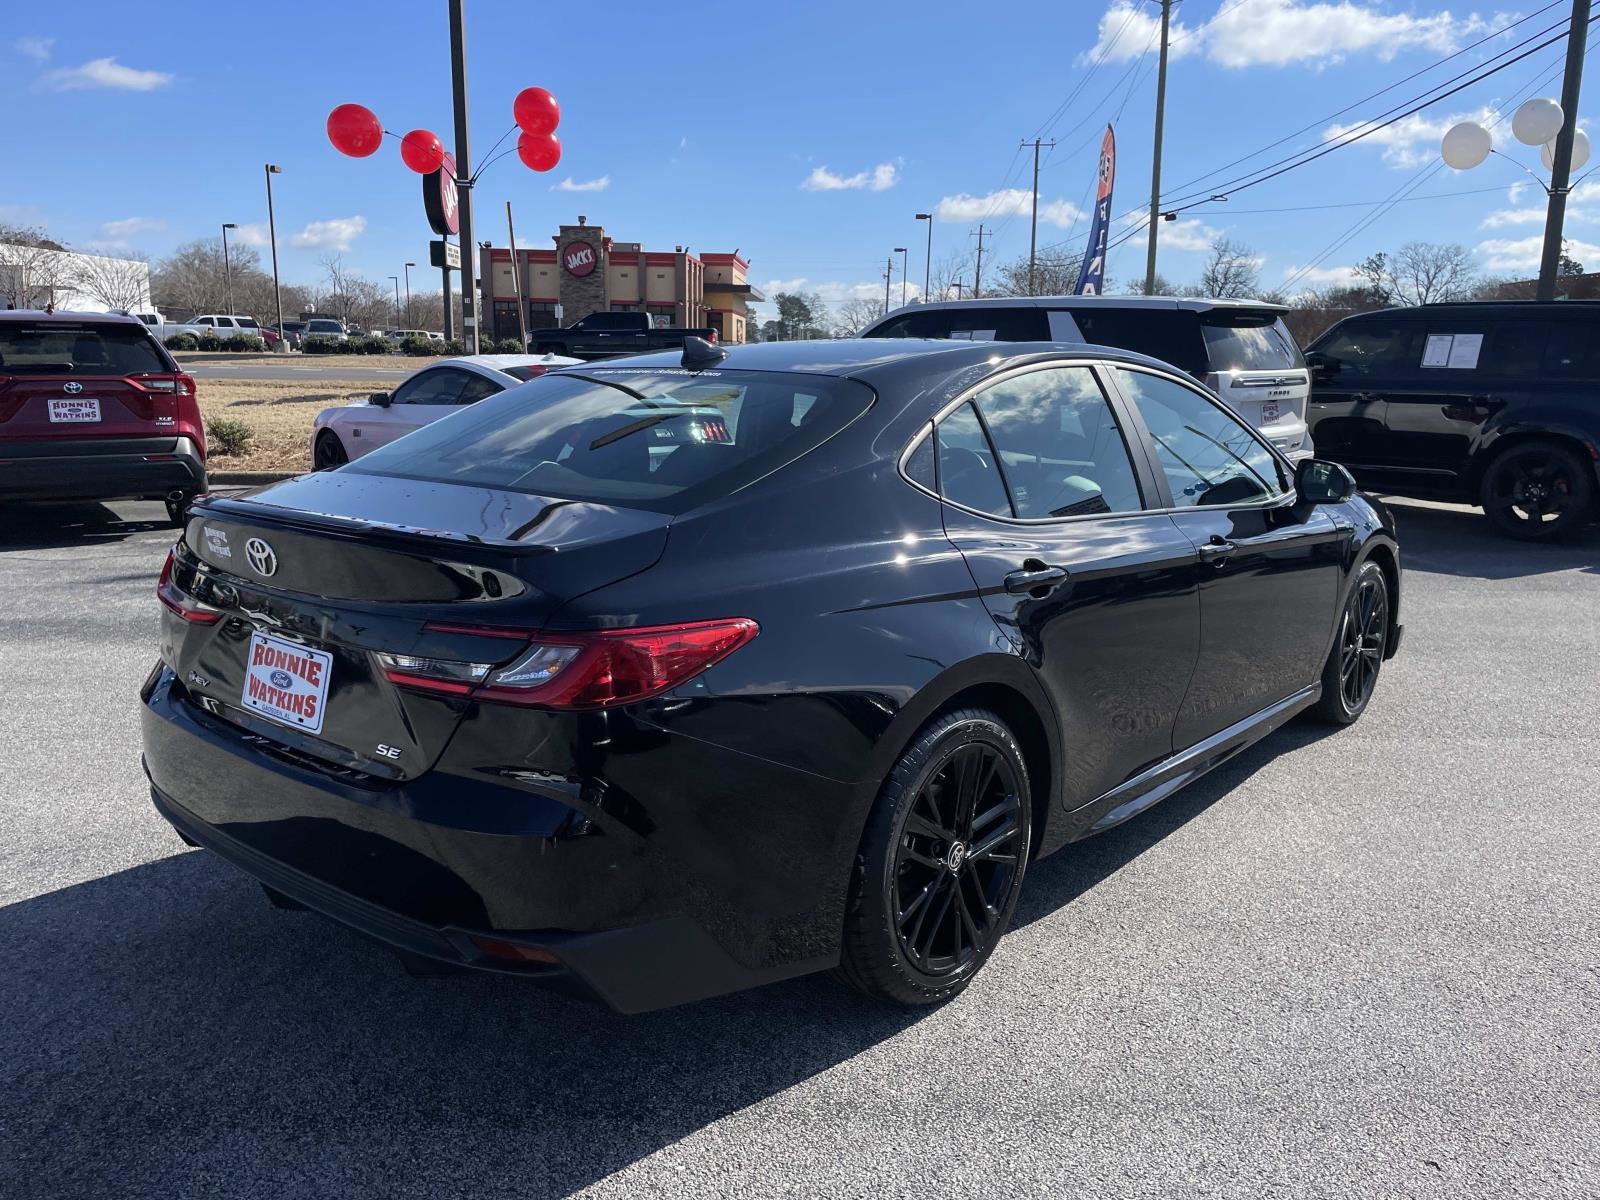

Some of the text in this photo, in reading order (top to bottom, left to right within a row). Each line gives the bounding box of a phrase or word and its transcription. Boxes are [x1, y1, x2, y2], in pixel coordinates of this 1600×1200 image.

[52, 402, 96, 410] RONNIE
[53, 411, 97, 419] WATKINS
[252, 643, 322, 688] RONNIE
[248, 673, 318, 718] WATKINS
[375, 743, 402, 760] SE
